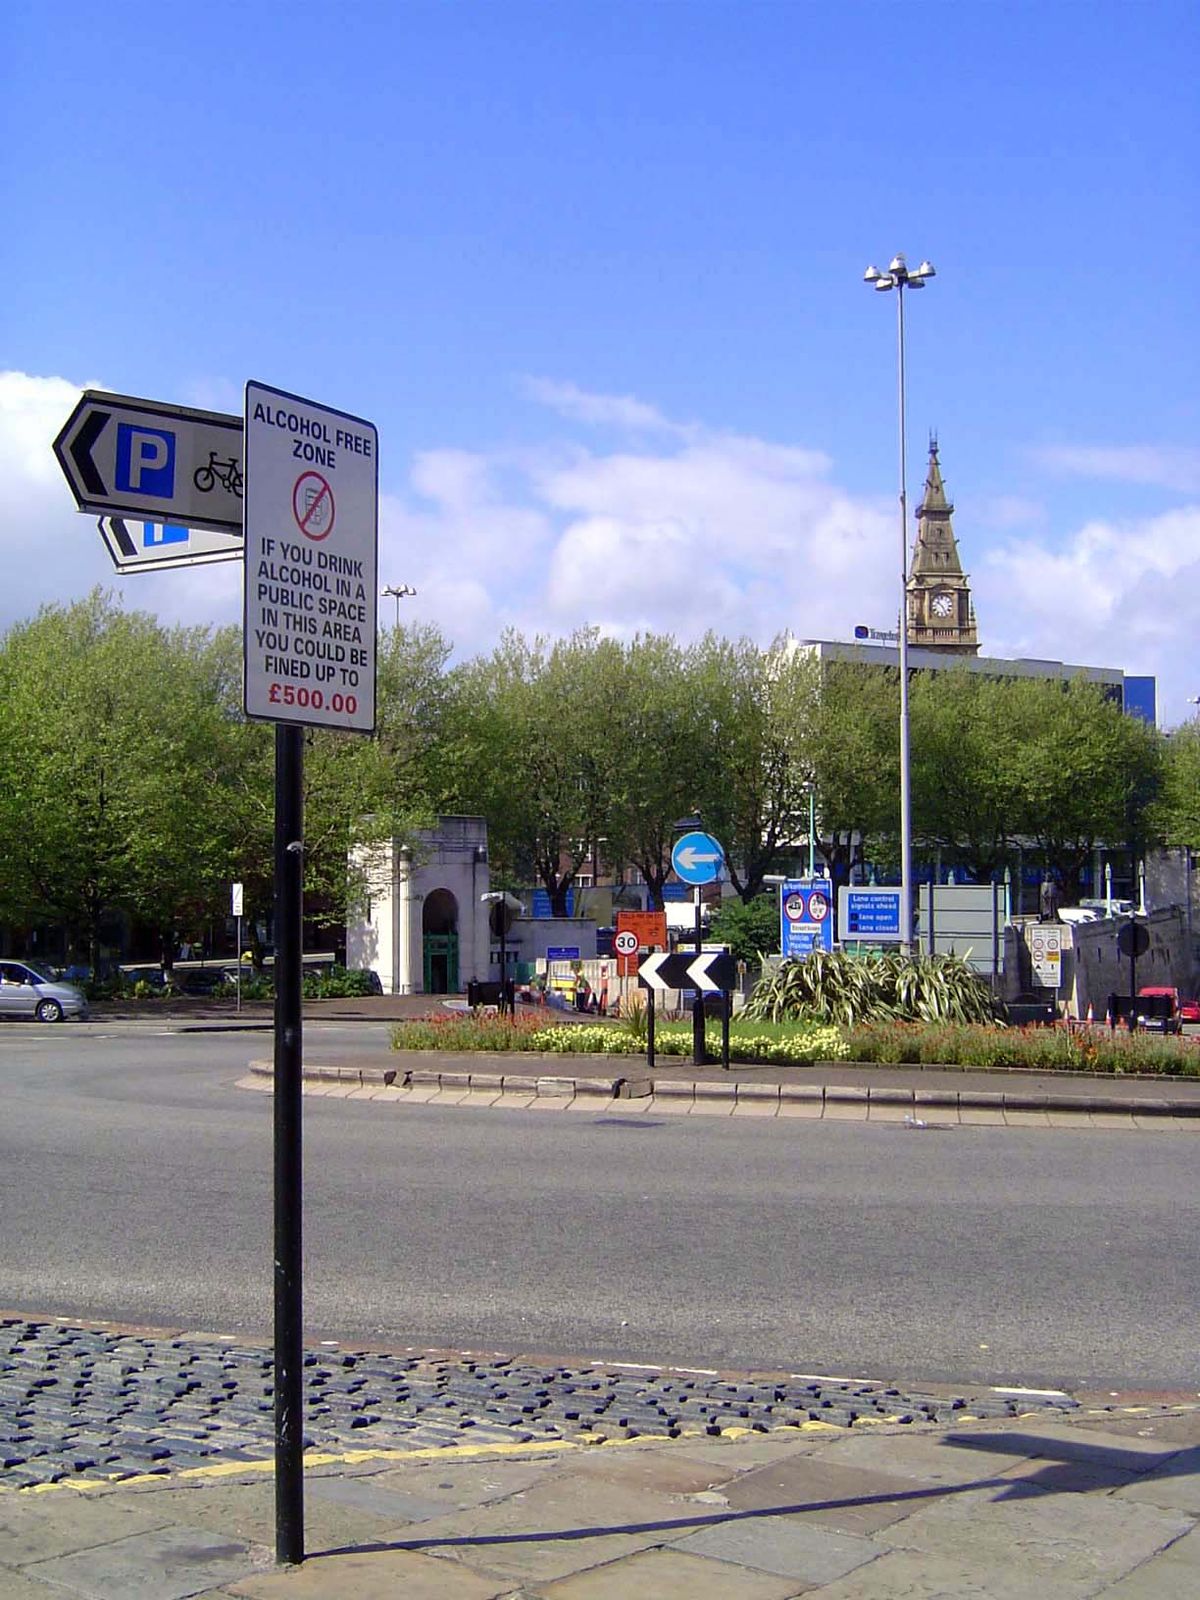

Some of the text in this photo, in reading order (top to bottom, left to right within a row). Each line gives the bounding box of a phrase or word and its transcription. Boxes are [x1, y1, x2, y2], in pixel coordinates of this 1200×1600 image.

[253, 403, 371, 457] ALCOHOL FREE
[129, 431, 168, 488] P
[293, 439, 336, 469] ZONE
[262, 537, 363, 578] IF YOU DRINK
[258, 560, 366, 601] ALCOHOL IN A
[258, 583, 366, 623] PUBLIC SPACE
[262, 607, 362, 644] IN THIS AREA
[255, 629, 368, 667] YOU COULD BE
[265, 655, 359, 687] FINED UP TO
[268, 683, 357, 714] £500.00
[853, 894, 895, 902] Lane control
[617, 937, 636, 948] 30
